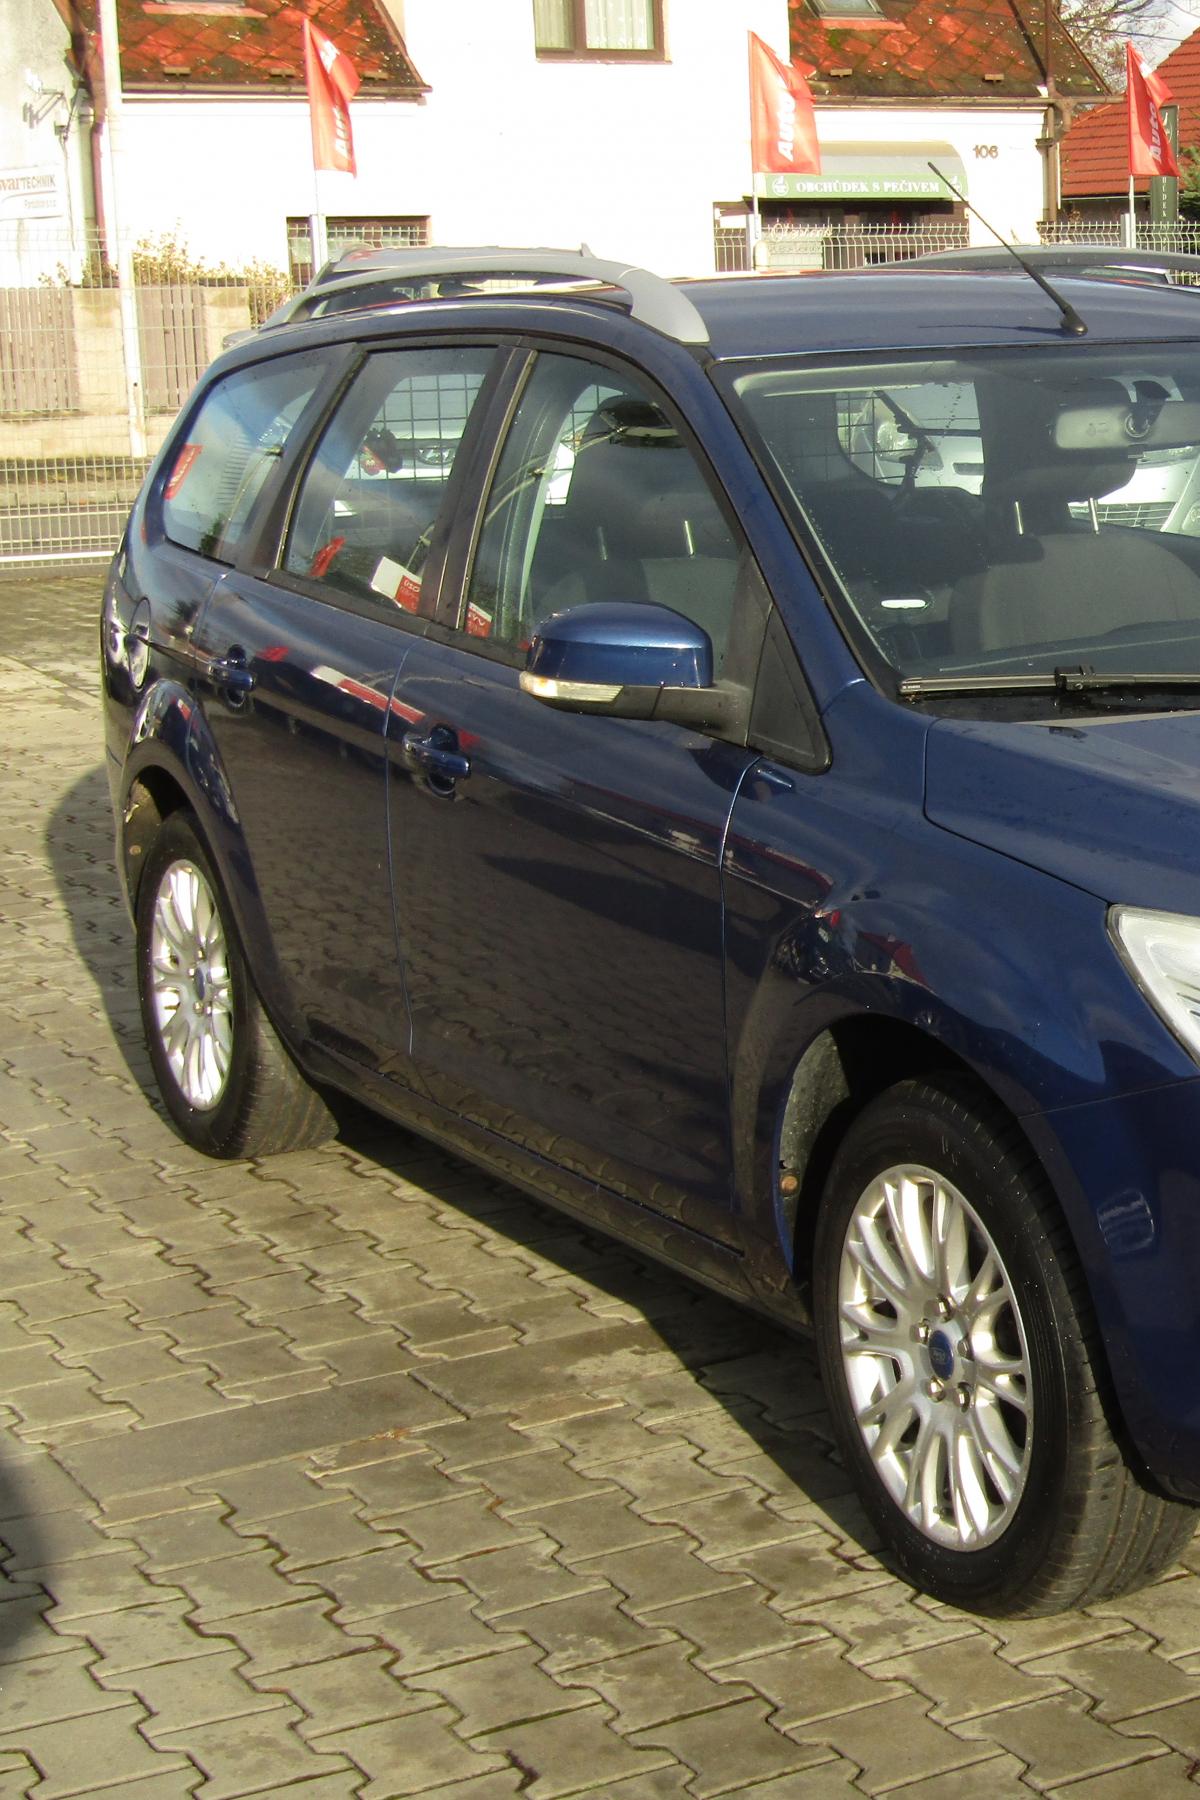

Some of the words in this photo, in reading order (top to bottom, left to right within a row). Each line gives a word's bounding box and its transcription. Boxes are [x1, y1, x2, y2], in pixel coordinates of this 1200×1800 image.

[972, 144, 999, 159] 106
[796, 179, 870, 193] OBCHŮDEK
[872, 181, 881, 193] S
[883, 179, 940, 193] PEČIVEM
